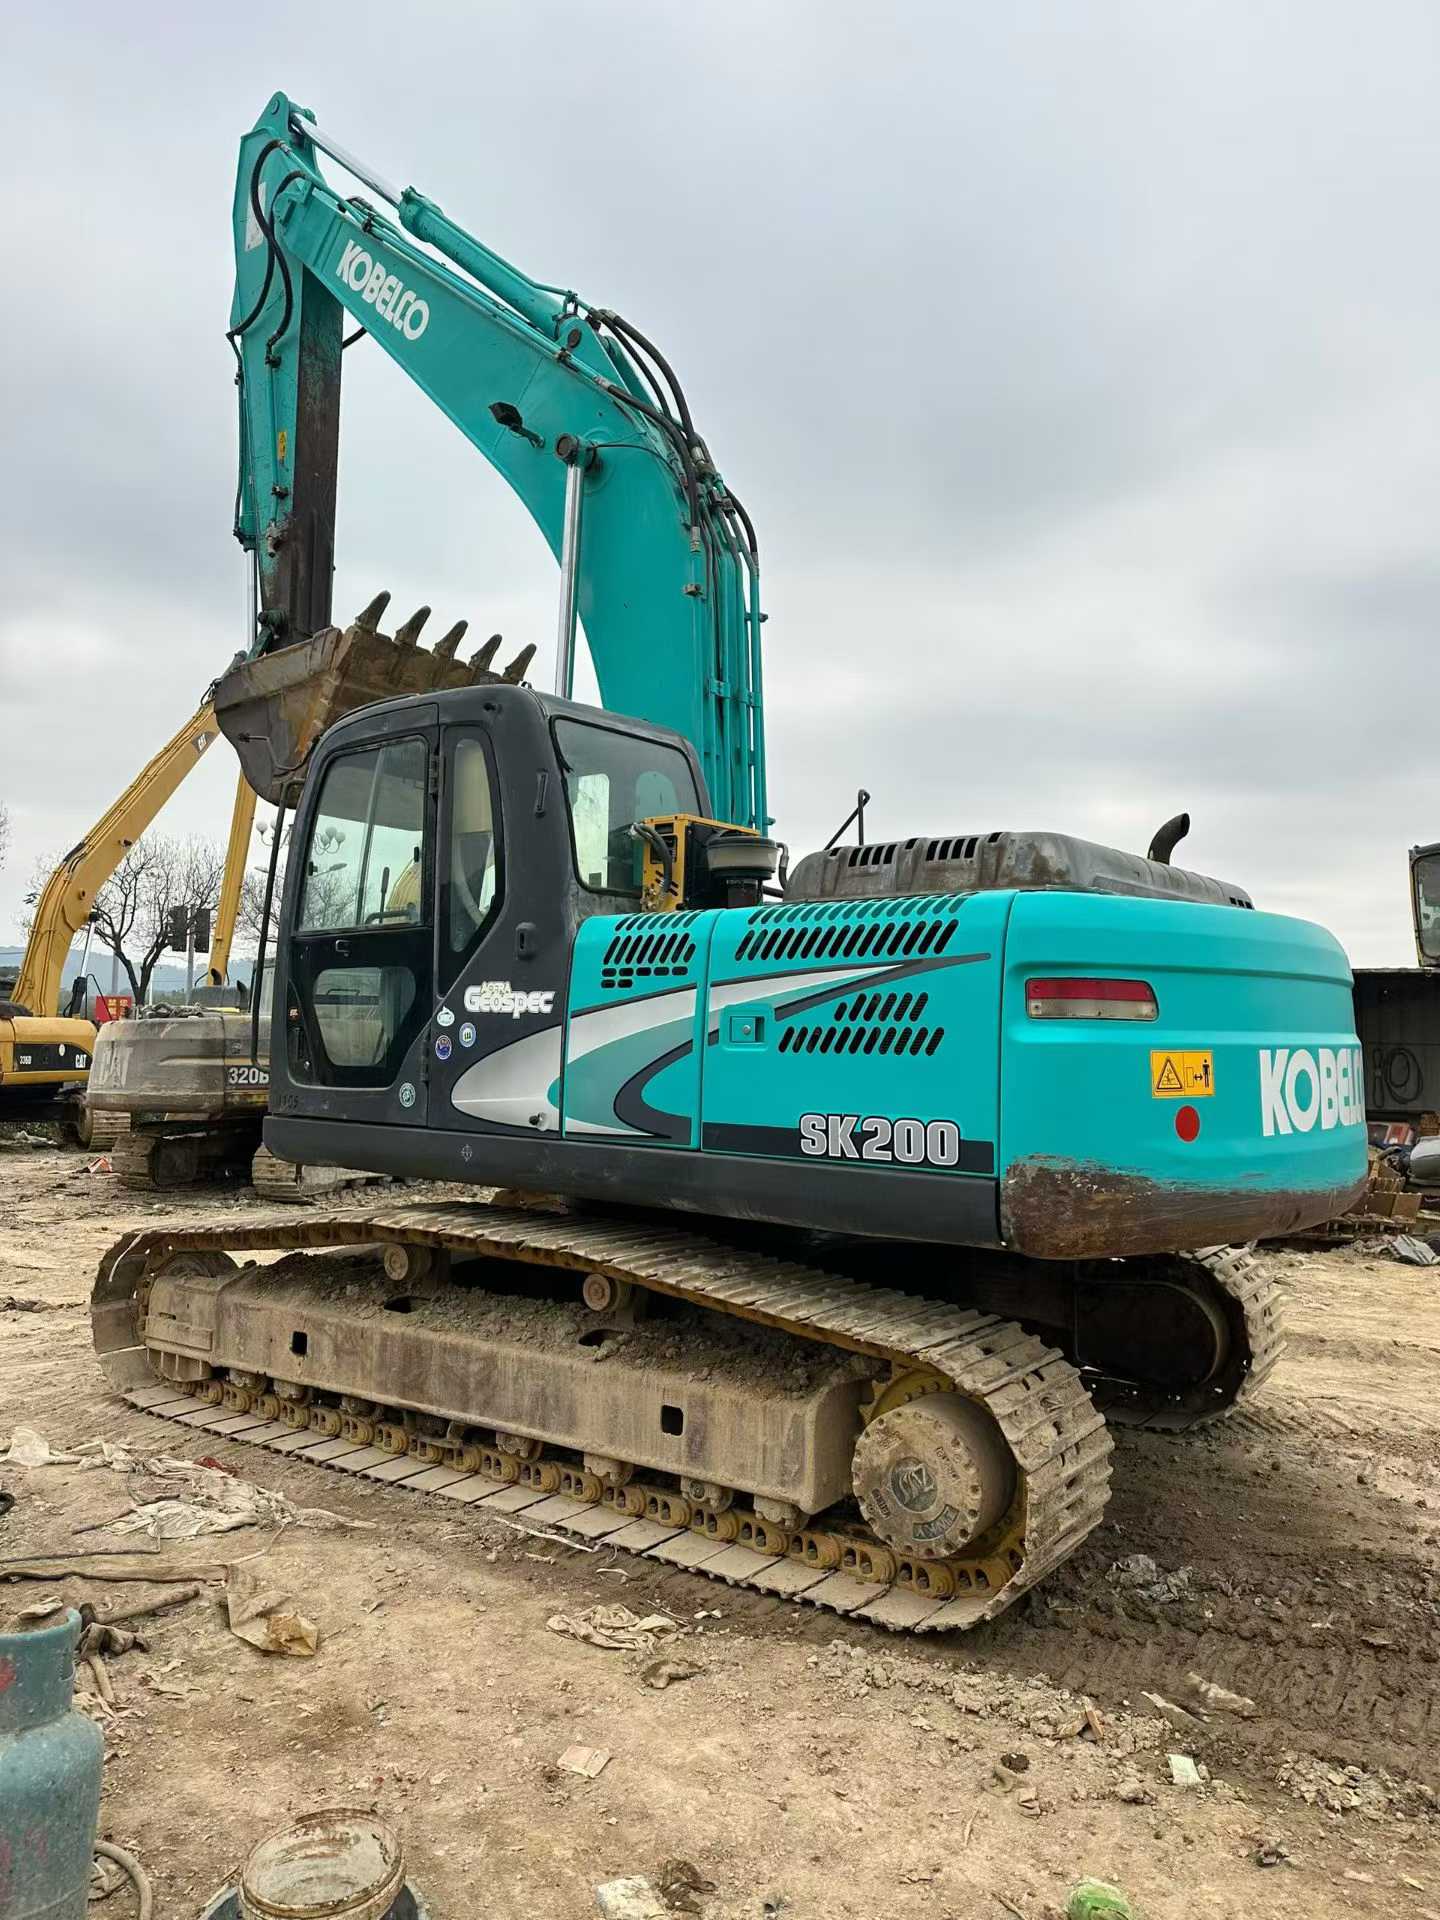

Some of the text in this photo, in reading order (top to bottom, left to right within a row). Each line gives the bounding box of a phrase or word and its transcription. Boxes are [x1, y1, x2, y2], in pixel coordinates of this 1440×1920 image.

[336, 239, 429, 340] KOBELCO
[75, 1054, 87, 1068] CAT
[799, 1112, 960, 1167] SK200
